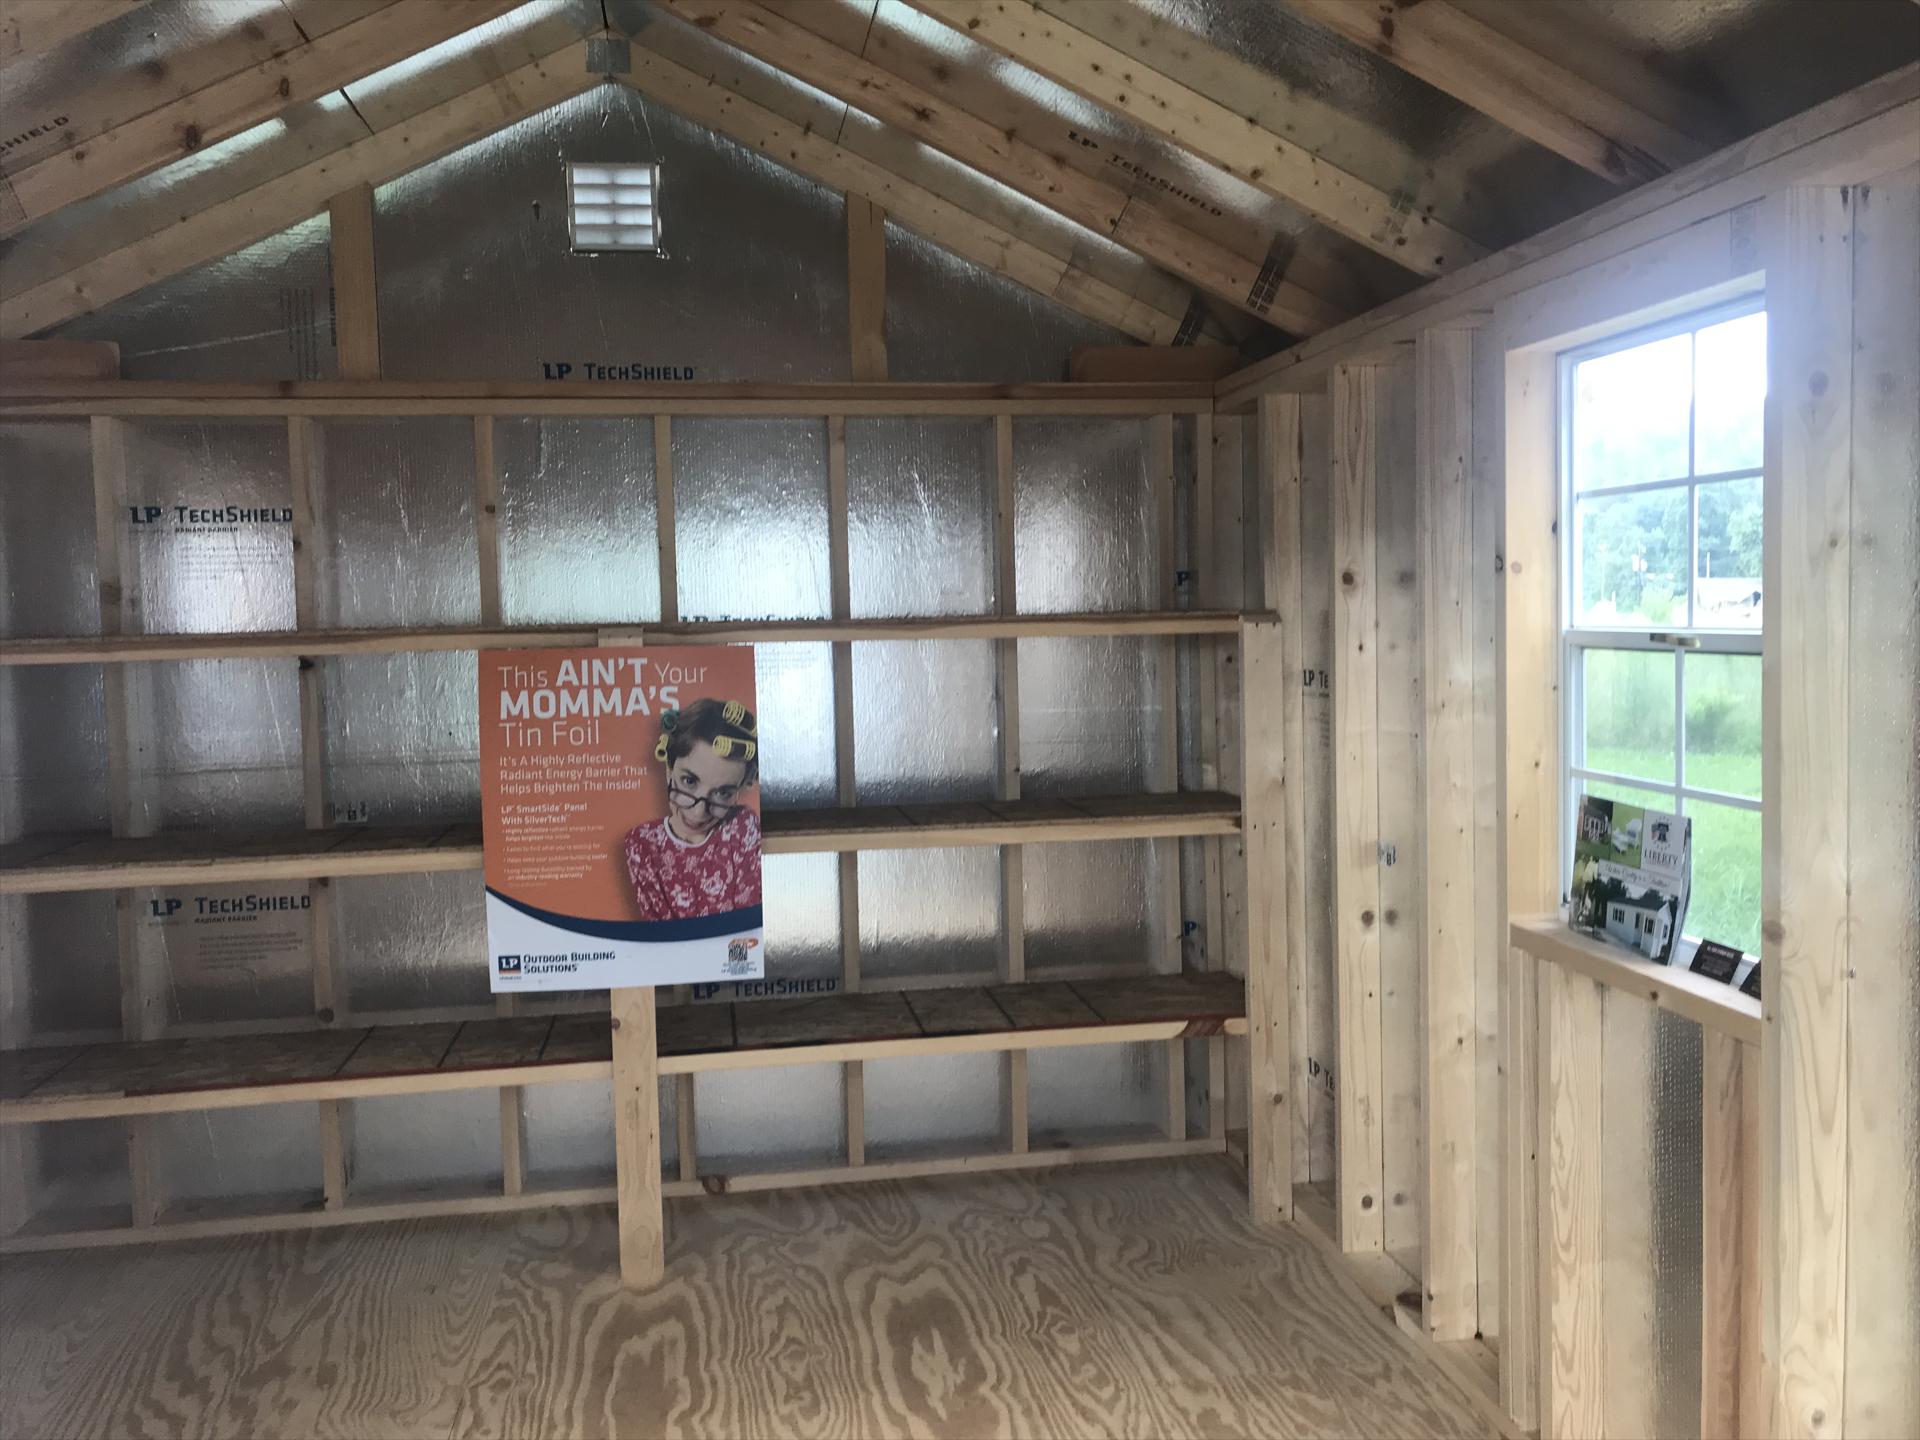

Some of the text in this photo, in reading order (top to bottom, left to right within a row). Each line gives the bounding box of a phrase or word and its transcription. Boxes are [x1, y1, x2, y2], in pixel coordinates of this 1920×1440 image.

[543, 362, 572, 380] LP
[129, 506, 162, 524] LP
[497, 657, 708, 689] This AIN'T Your
[1303, 669, 1315, 688] LP
[500, 685, 680, 721] MOMMA'S
[498, 719, 600, 748] Tin Foil
[500, 752, 622, 769] It's A Highly Reflective
[500, 765, 648, 781] Radiant Energy Barrier That
[500, 779, 641, 796] Helps Brighten The Inside!
[501, 805, 512, 814] LP
[564, 802, 588, 812] Panel
[501, 814, 567, 825] With SilverTech
[1644, 849, 1678, 865] LIBERTY
[150, 898, 182, 916] LP
[501, 957, 518, 969] LP
[523, 951, 616, 964] OUTDOOR BUILDING
[523, 964, 578, 974] SOLUTIONS
[693, 982, 720, 1000] LP
